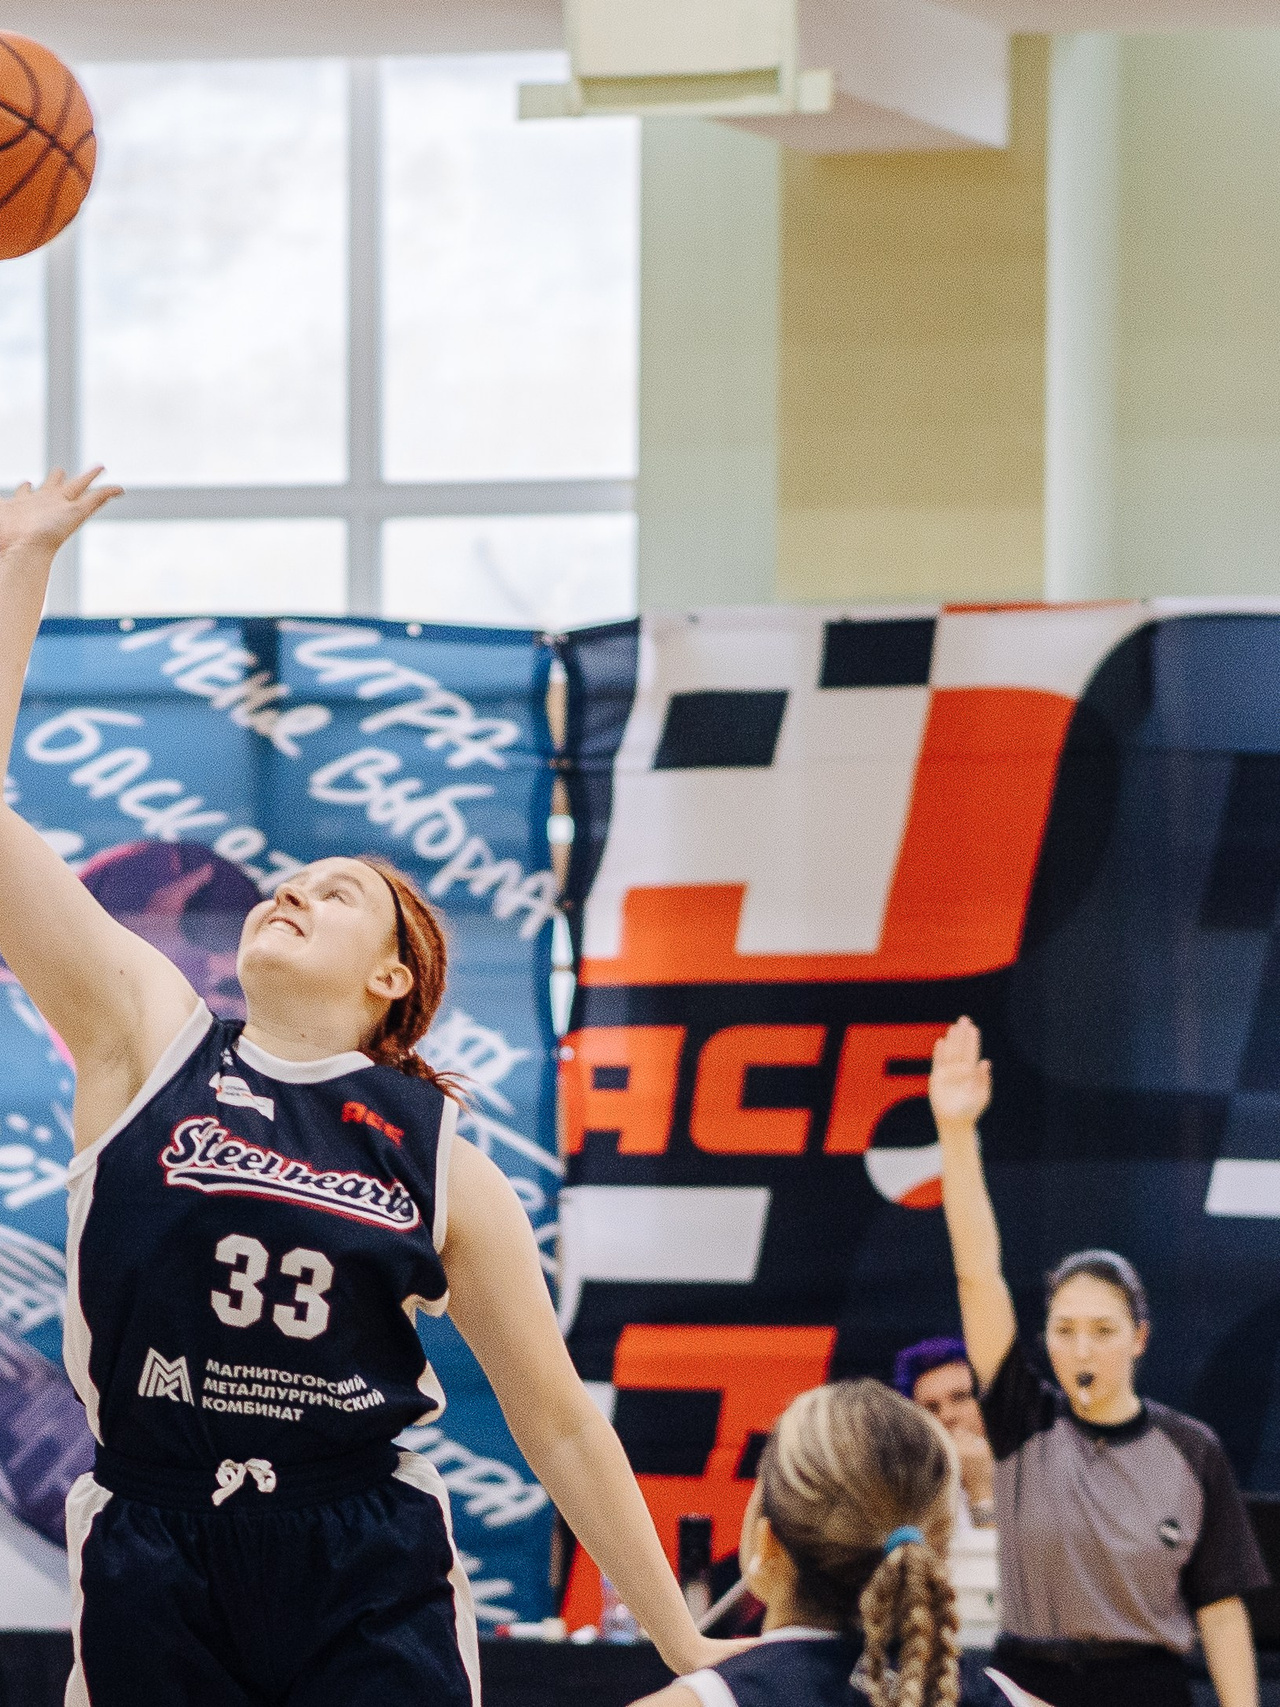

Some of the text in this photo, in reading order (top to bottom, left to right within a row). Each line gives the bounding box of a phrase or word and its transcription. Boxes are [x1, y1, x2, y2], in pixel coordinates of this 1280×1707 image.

[210, 1232, 335, 1341] 33
[202, 1377, 386, 1413] МЕТАЛЛУРГИЧЕСКИЙ
[204, 1358, 368, 1397] МАГНИТОГОРСКИЙ
[200, 1395, 304, 1422] КОМБИНАТ
